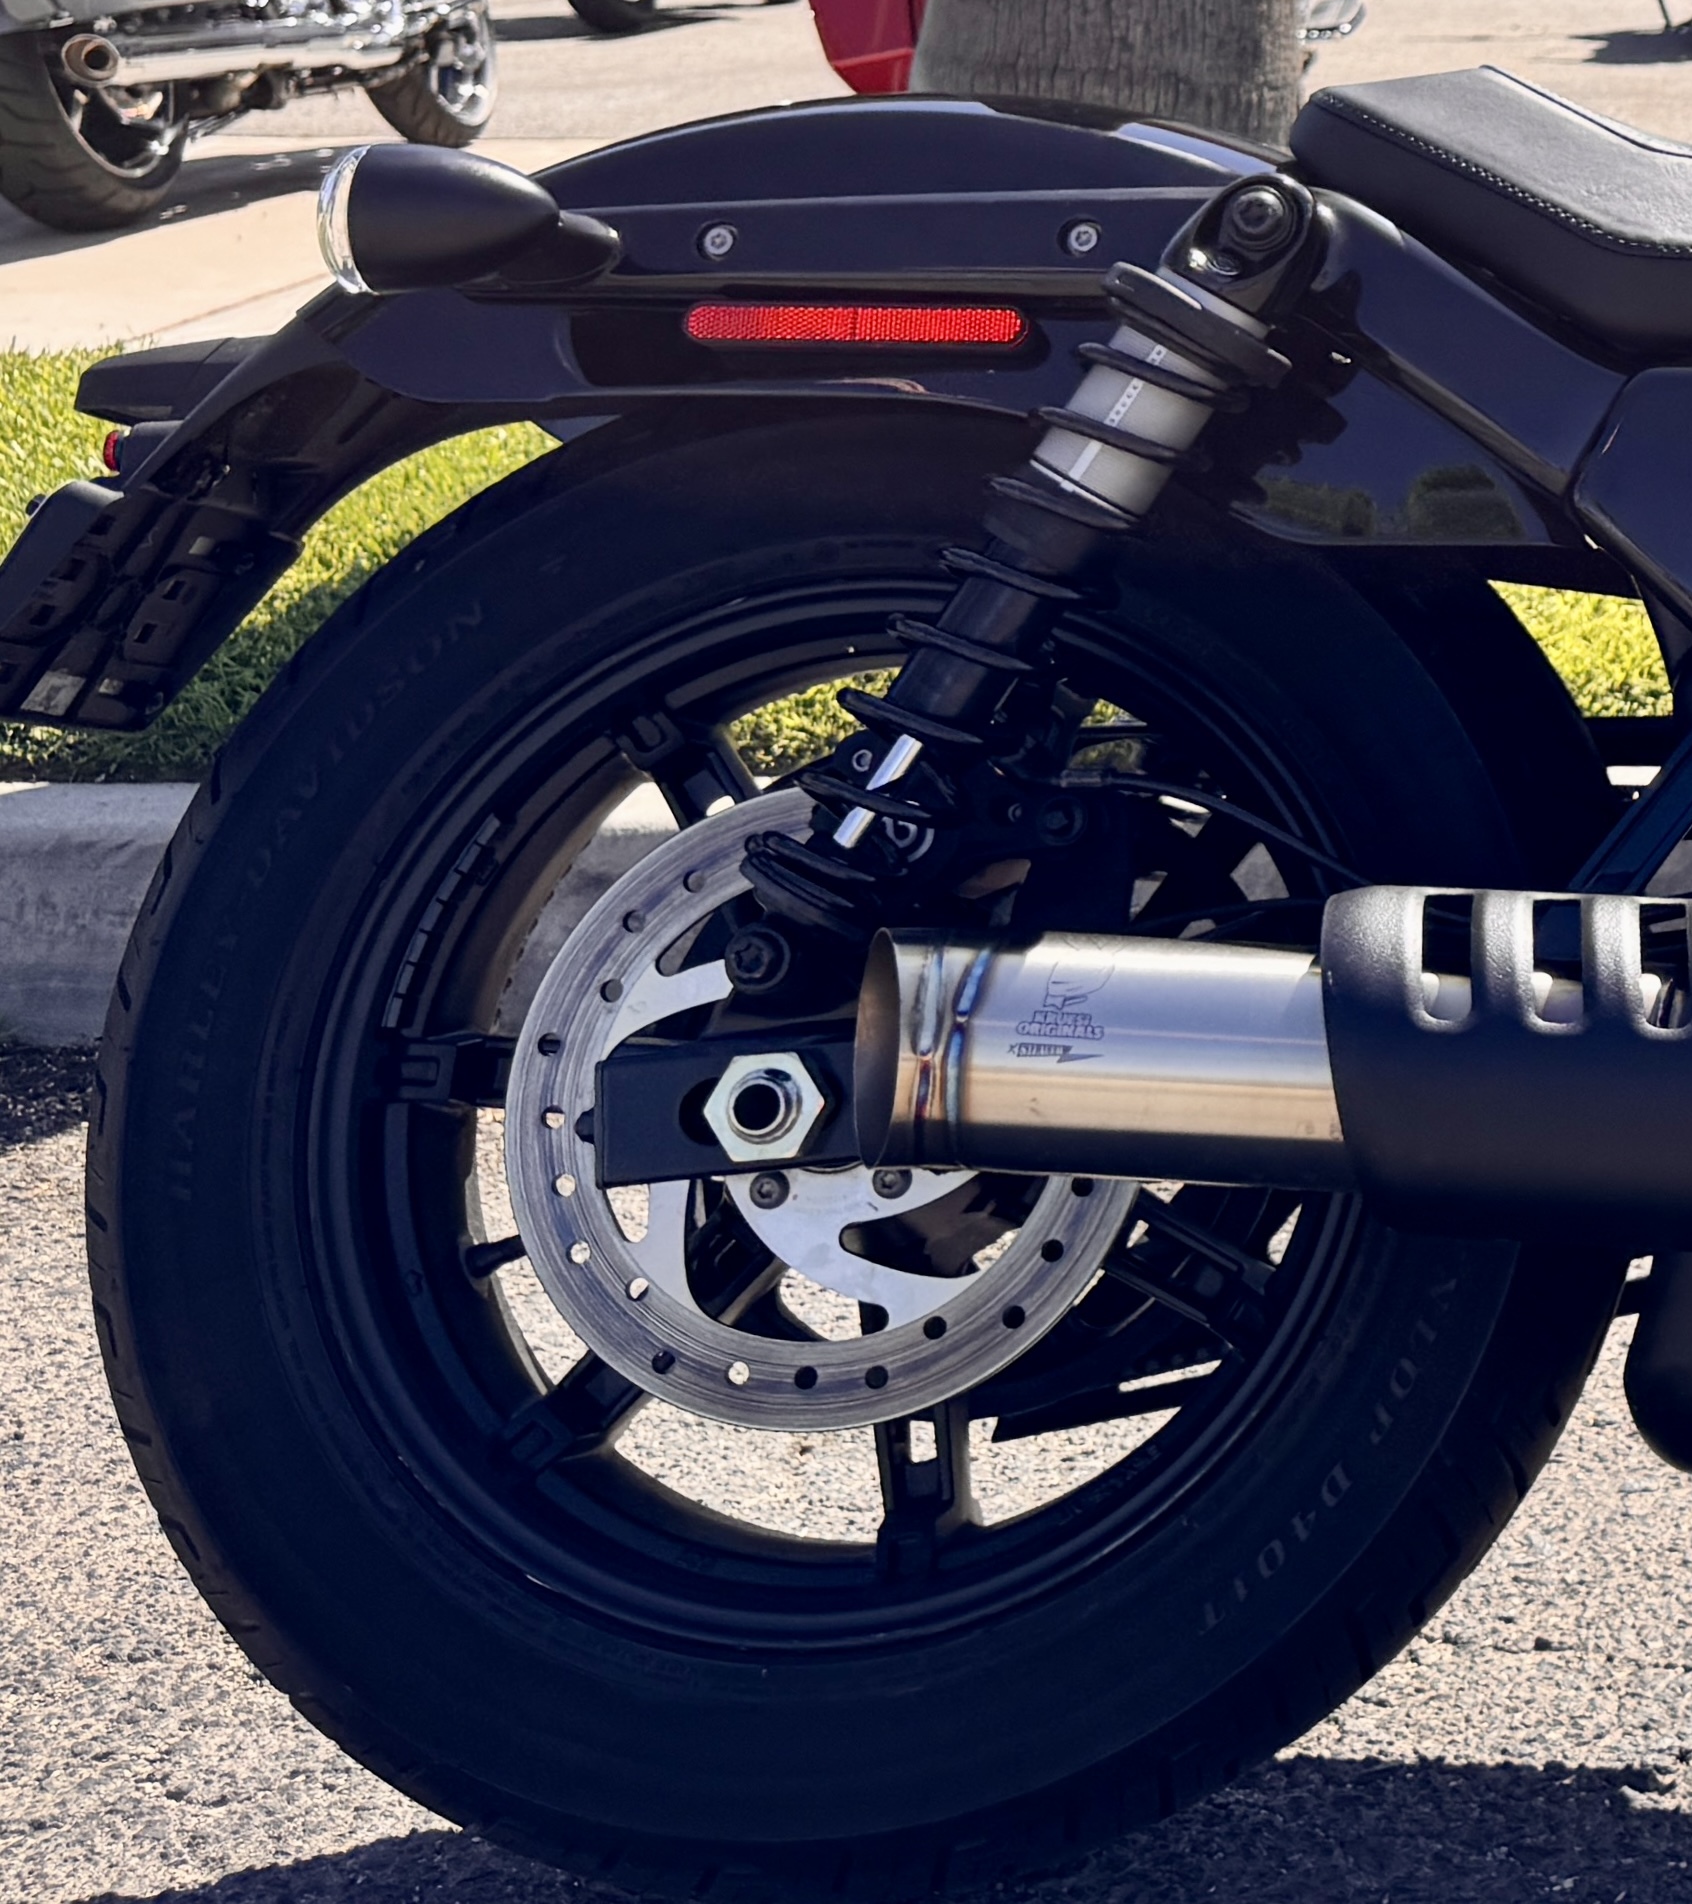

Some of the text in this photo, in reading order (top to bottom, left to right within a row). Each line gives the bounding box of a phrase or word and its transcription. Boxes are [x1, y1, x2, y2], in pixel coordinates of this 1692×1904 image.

[1016, 1021, 1105, 1041] ORIGINALS
[1186, 1270, 1457, 1636] NLOP D401T
